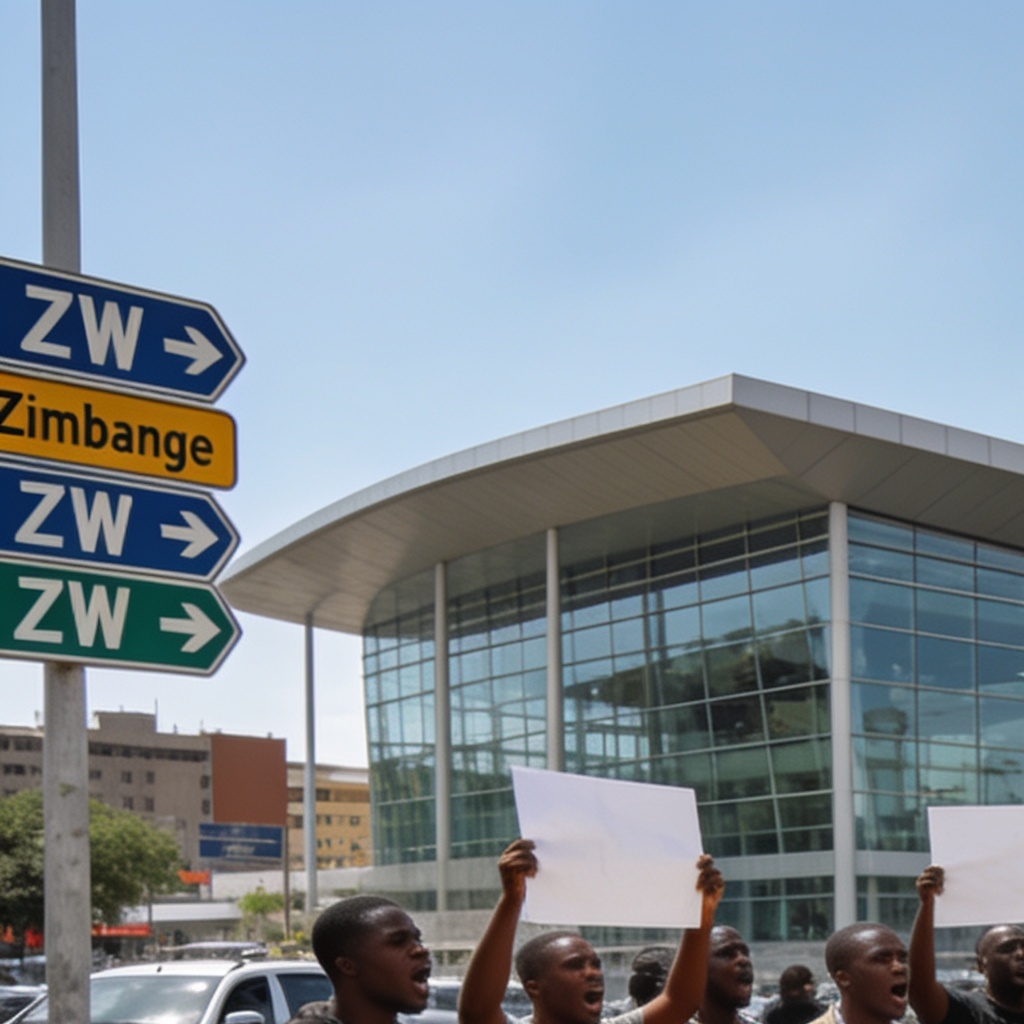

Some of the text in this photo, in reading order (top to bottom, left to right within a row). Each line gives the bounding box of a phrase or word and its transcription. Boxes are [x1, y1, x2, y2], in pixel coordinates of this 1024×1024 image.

[20, 283, 145, 372] ZW
[0, 389, 215, 474] Zimbange
[14, 479, 134, 557] ZW
[13, 576, 131, 650] ZW
